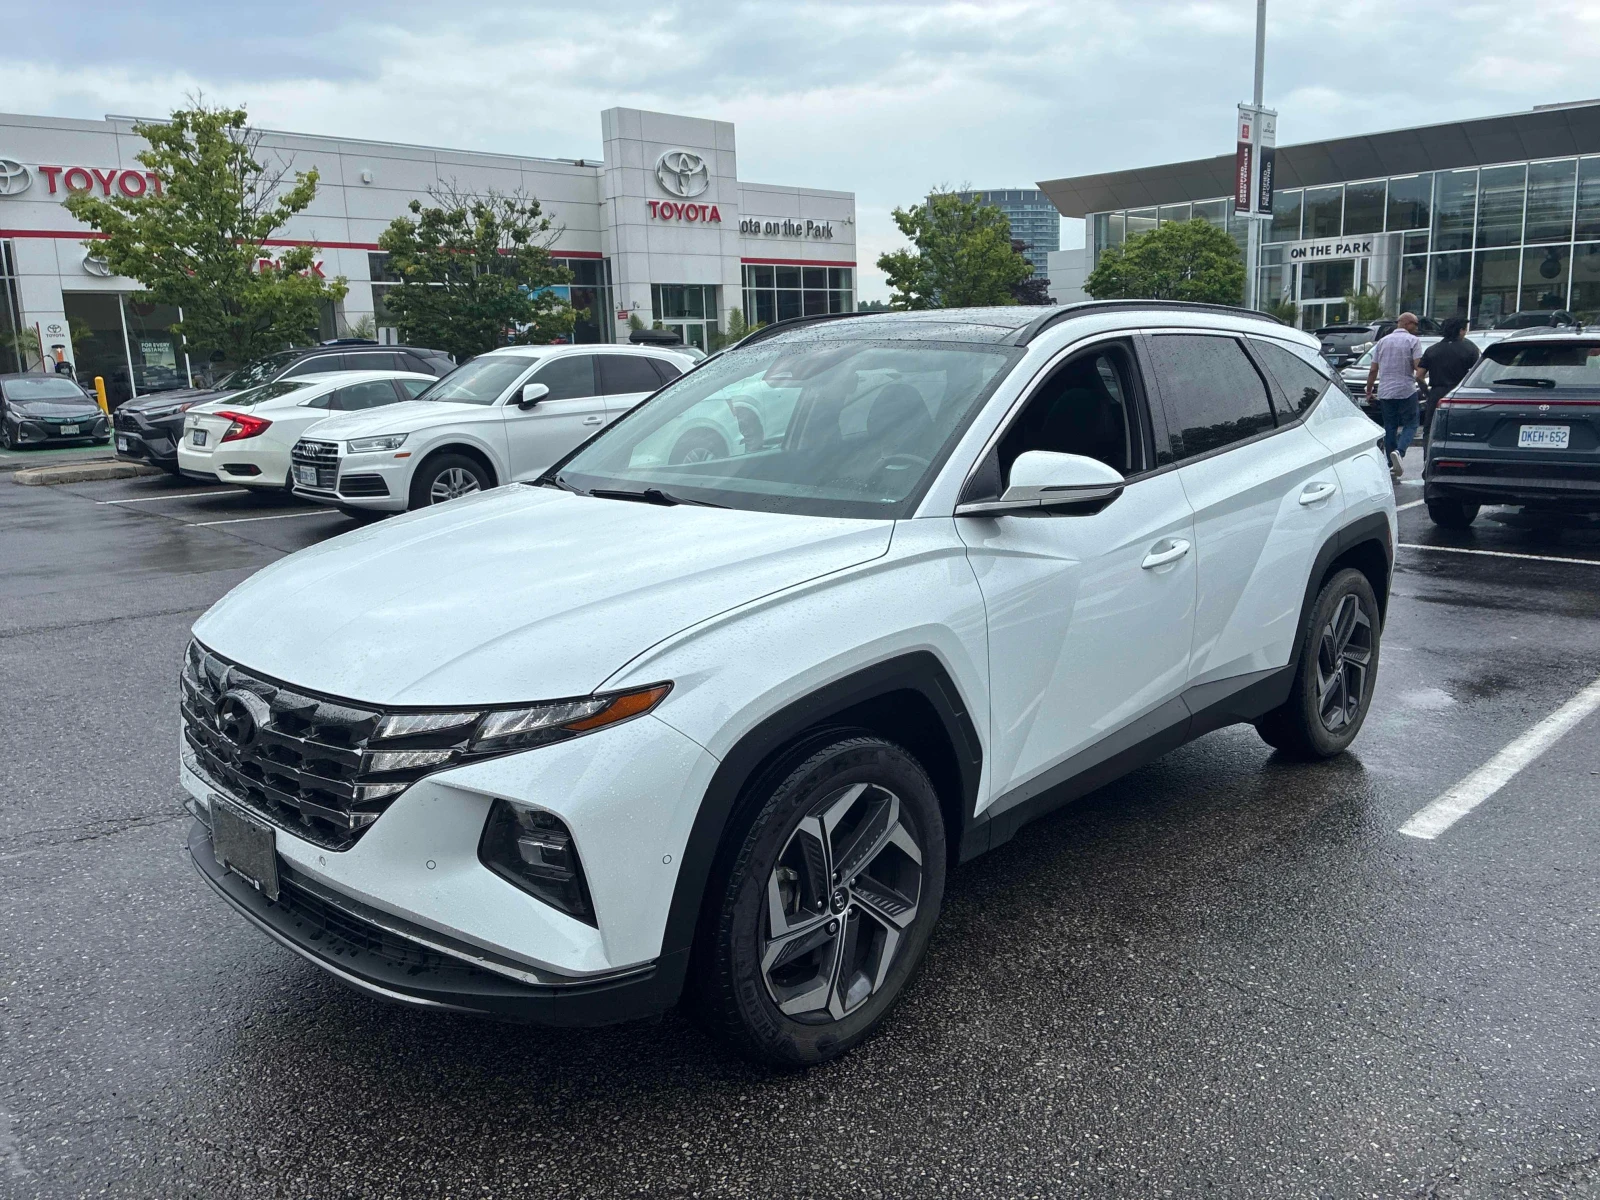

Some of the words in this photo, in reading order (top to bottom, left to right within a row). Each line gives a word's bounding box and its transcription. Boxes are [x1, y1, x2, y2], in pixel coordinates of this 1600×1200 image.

[38, 165, 165, 198] TOYOT
[648, 200, 722, 223] TOYOTA
[739, 218, 761, 234] ota
[765, 221, 780, 235] on
[783, 218, 803, 236] the
[806, 220, 834, 238] Park
[1291, 248, 1307, 259] ON
[1309, 245, 1332, 256] THE
[1336, 241, 1372, 254] PARK
